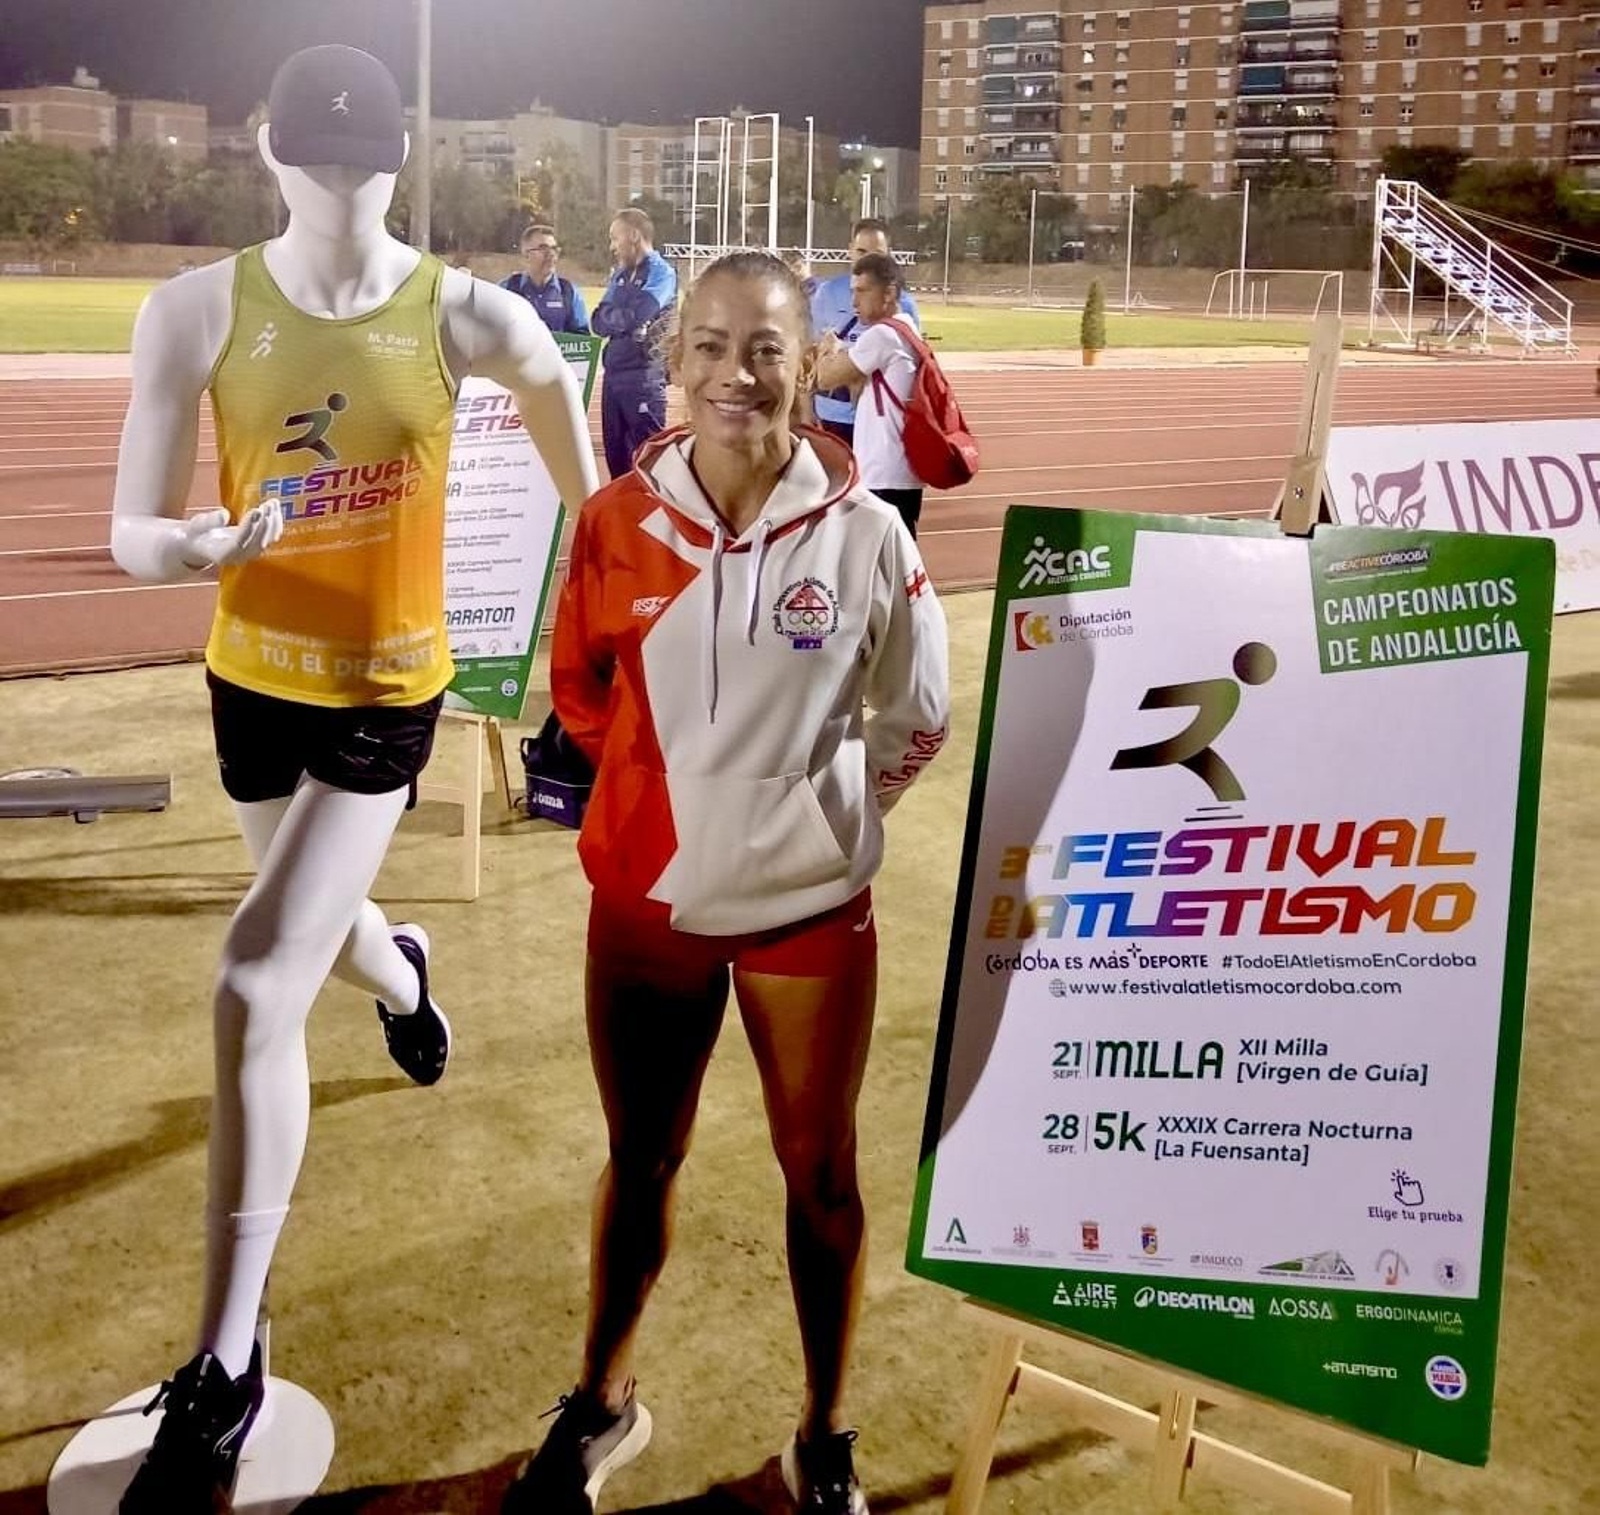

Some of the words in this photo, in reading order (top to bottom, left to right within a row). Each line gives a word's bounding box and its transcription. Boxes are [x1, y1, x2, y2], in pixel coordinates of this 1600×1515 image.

[559, 340, 591, 353] CIALES
[456, 394, 513, 413] ESTI
[454, 414, 524, 433] LETIS
[260, 456, 423, 497] FESTIVAL
[449, 459, 476, 472] ILLA
[281, 478, 421, 521] LETISMO
[1046, 545, 1111, 576] CAC
[1323, 577, 1517, 626] CAMPEONATOS
[1060, 608, 1132, 628] Diputación
[1060, 630, 1076, 643] de
[1327, 638, 1361, 667] DE
[1370, 613, 1521, 662] ANDALUCÍA
[302, 653, 327, 675] EL
[1052, 817, 1477, 880] FESTIVAL
[1017, 882, 1477, 939] ATLETISMO
[1065, 956, 1083, 969] ES
[1139, 955, 1208, 969] DEPORTE
[1222, 953, 1477, 970] #TodoElAtletismoEnCordoba
[1069, 978, 1402, 997] www.festivalatletismocordoba.com
[1052, 1042, 1083, 1067] 21
[1238, 1038, 1267, 1056] XII
[1275, 1037, 1328, 1056] Milla
[1095, 1040, 1224, 1079] MILLA
[1052, 1069, 1082, 1080] SEPT.
[1237, 1061, 1320, 1084] [Virgen
[1328, 1063, 1357, 1081] de
[1042, 1113, 1079, 1140] 28
[1093, 1110, 1149, 1152] 5k
[1157, 1116, 1217, 1134] XXXIX
[1224, 1117, 1301, 1136] Carrera
[1308, 1120, 1412, 1140] Nocturna
[1047, 1144, 1077, 1155] SEPT.
[1155, 1139, 1183, 1160] [La
[1191, 1141, 1309, 1167] Fuensanta]
[1368, 1206, 1398, 1221] Elige
[1402, 1209, 1415, 1220] tu
[1420, 1211, 1463, 1223] prueba
[1074, 1283, 1118, 1300] AIRE
[1157, 1290, 1255, 1315] DECATHLON
[1269, 1297, 1333, 1320] AOSSA
